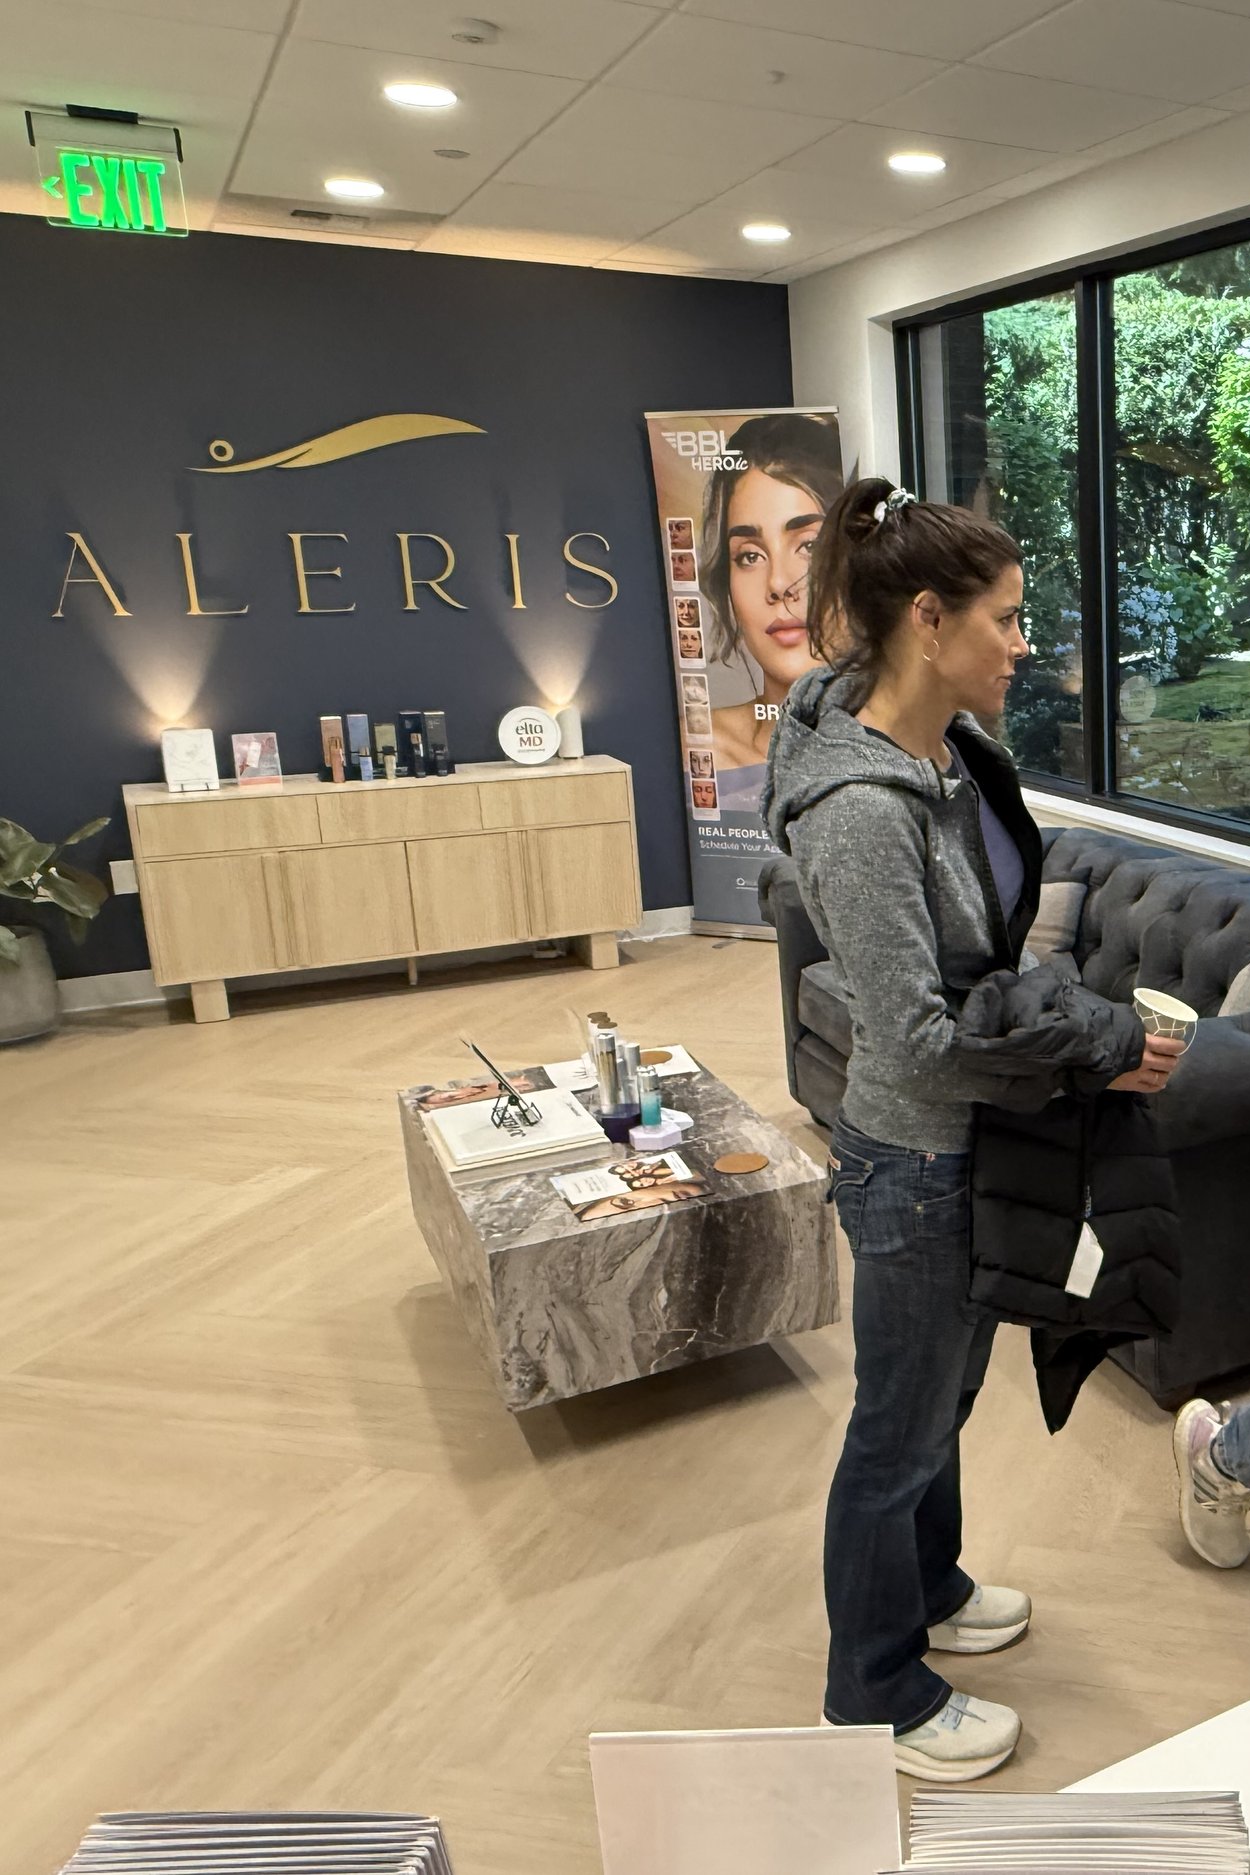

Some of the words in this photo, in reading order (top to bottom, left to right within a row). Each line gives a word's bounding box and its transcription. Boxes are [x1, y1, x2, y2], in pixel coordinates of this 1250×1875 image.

[60, 153, 166, 231] EXIT
[676, 430, 743, 456] BBL
[691, 456, 749, 471] HEROic
[51, 532, 619, 618] ALERIS
[519, 736, 543, 748] MD
[698, 827, 726, 837] REAL
[700, 840, 740, 851] Schedule
[741, 843, 762, 852] Your
